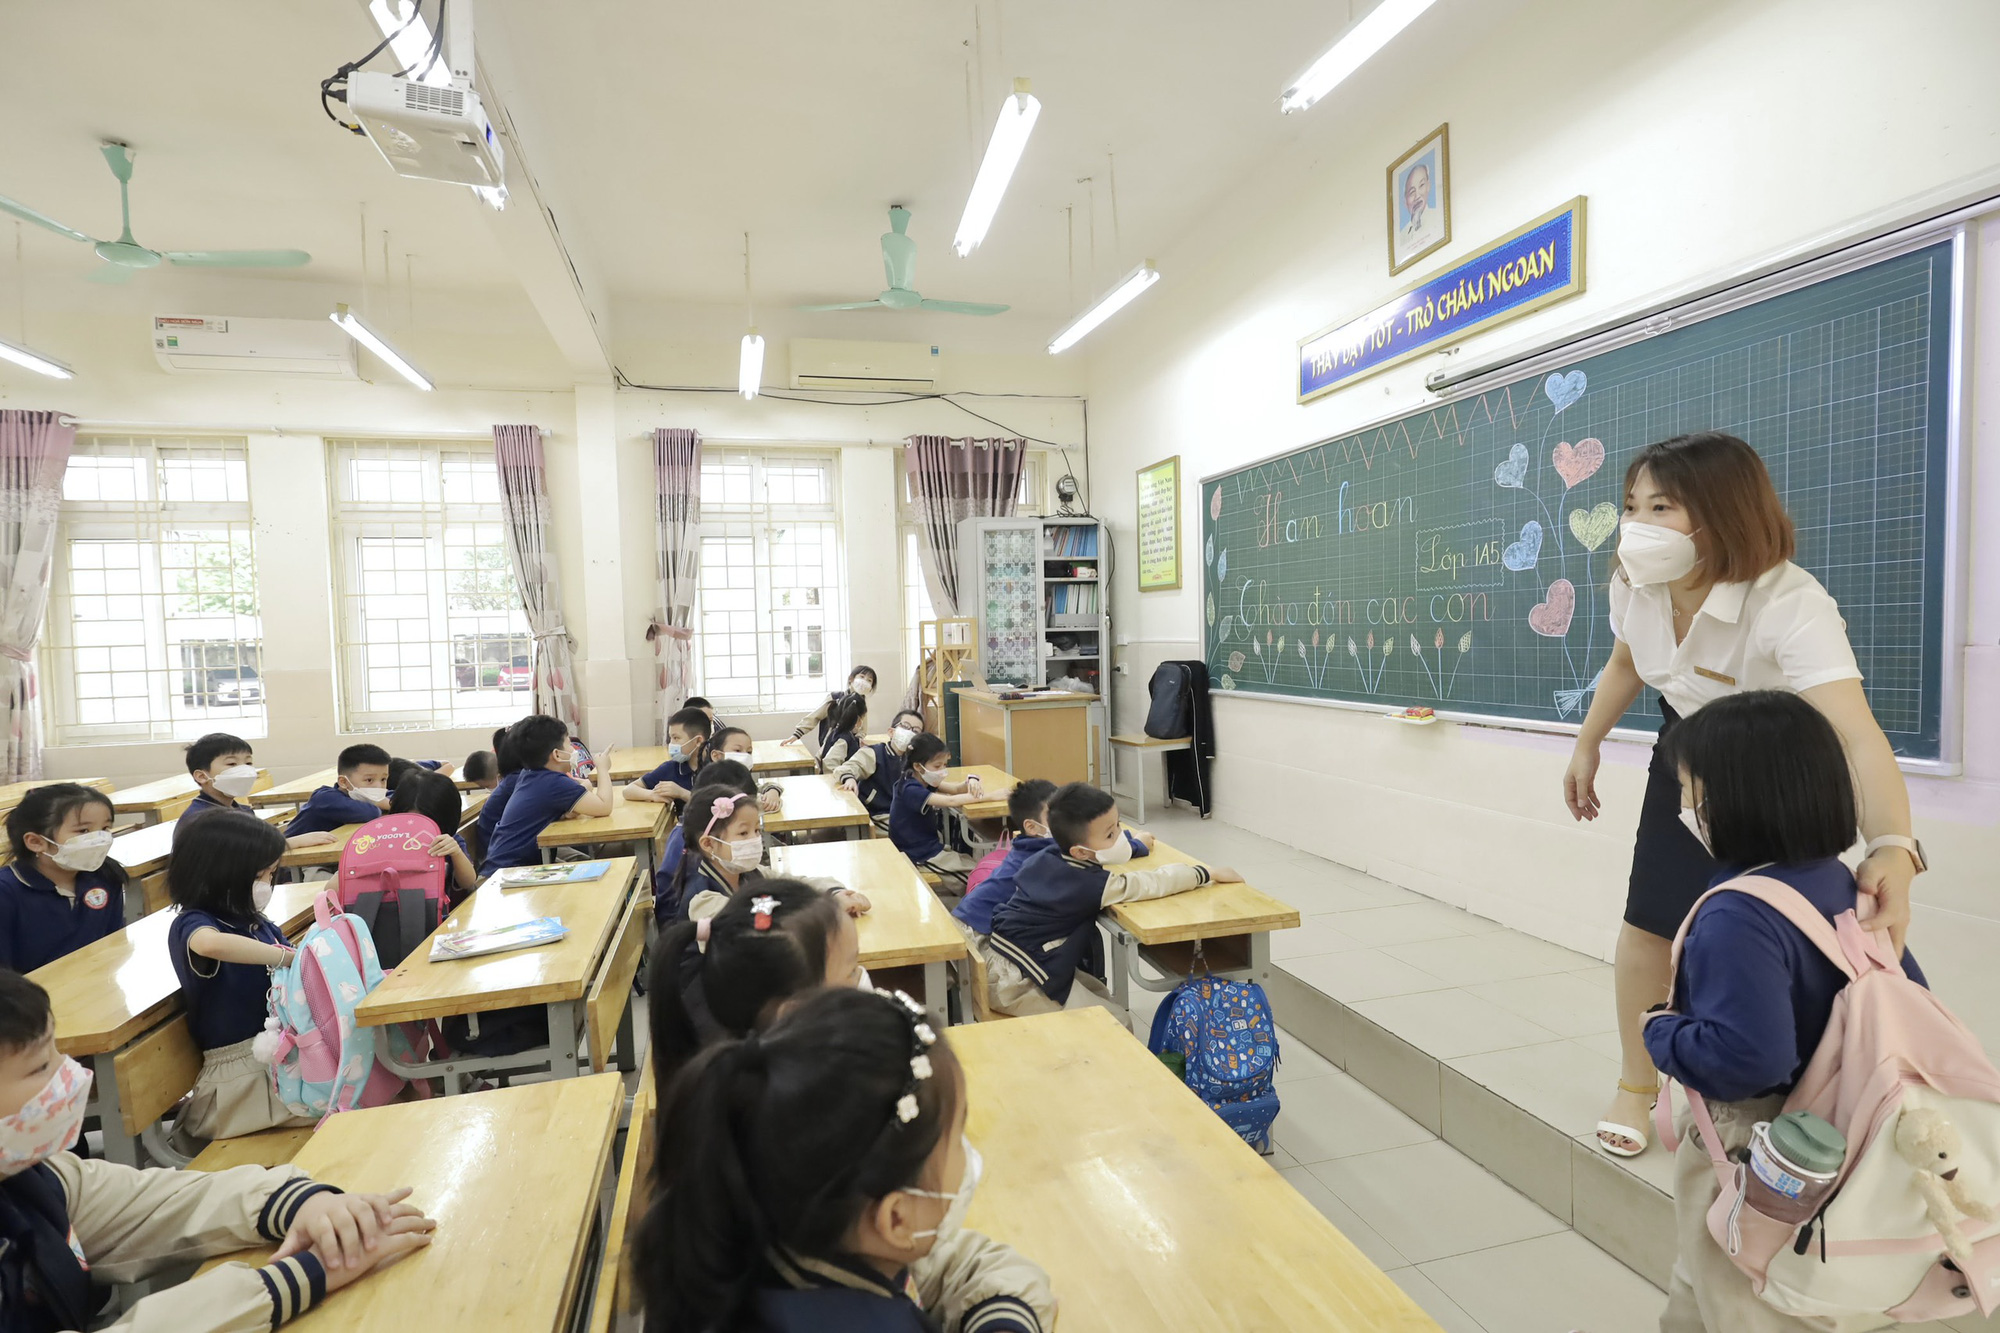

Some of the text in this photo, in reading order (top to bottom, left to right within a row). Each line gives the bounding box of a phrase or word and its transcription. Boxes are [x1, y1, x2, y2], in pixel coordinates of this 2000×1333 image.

[1405, 296, 1435, 336] TRÒ
[1437, 273, 1485, 321] CHĂM
[1487, 240, 1555, 300] NGOAN
[1338, 481, 1419, 534] hoan
[1420, 534, 1500, 580] Lớp 1A5
[1234, 575, 1496, 641] Chào đón các con
